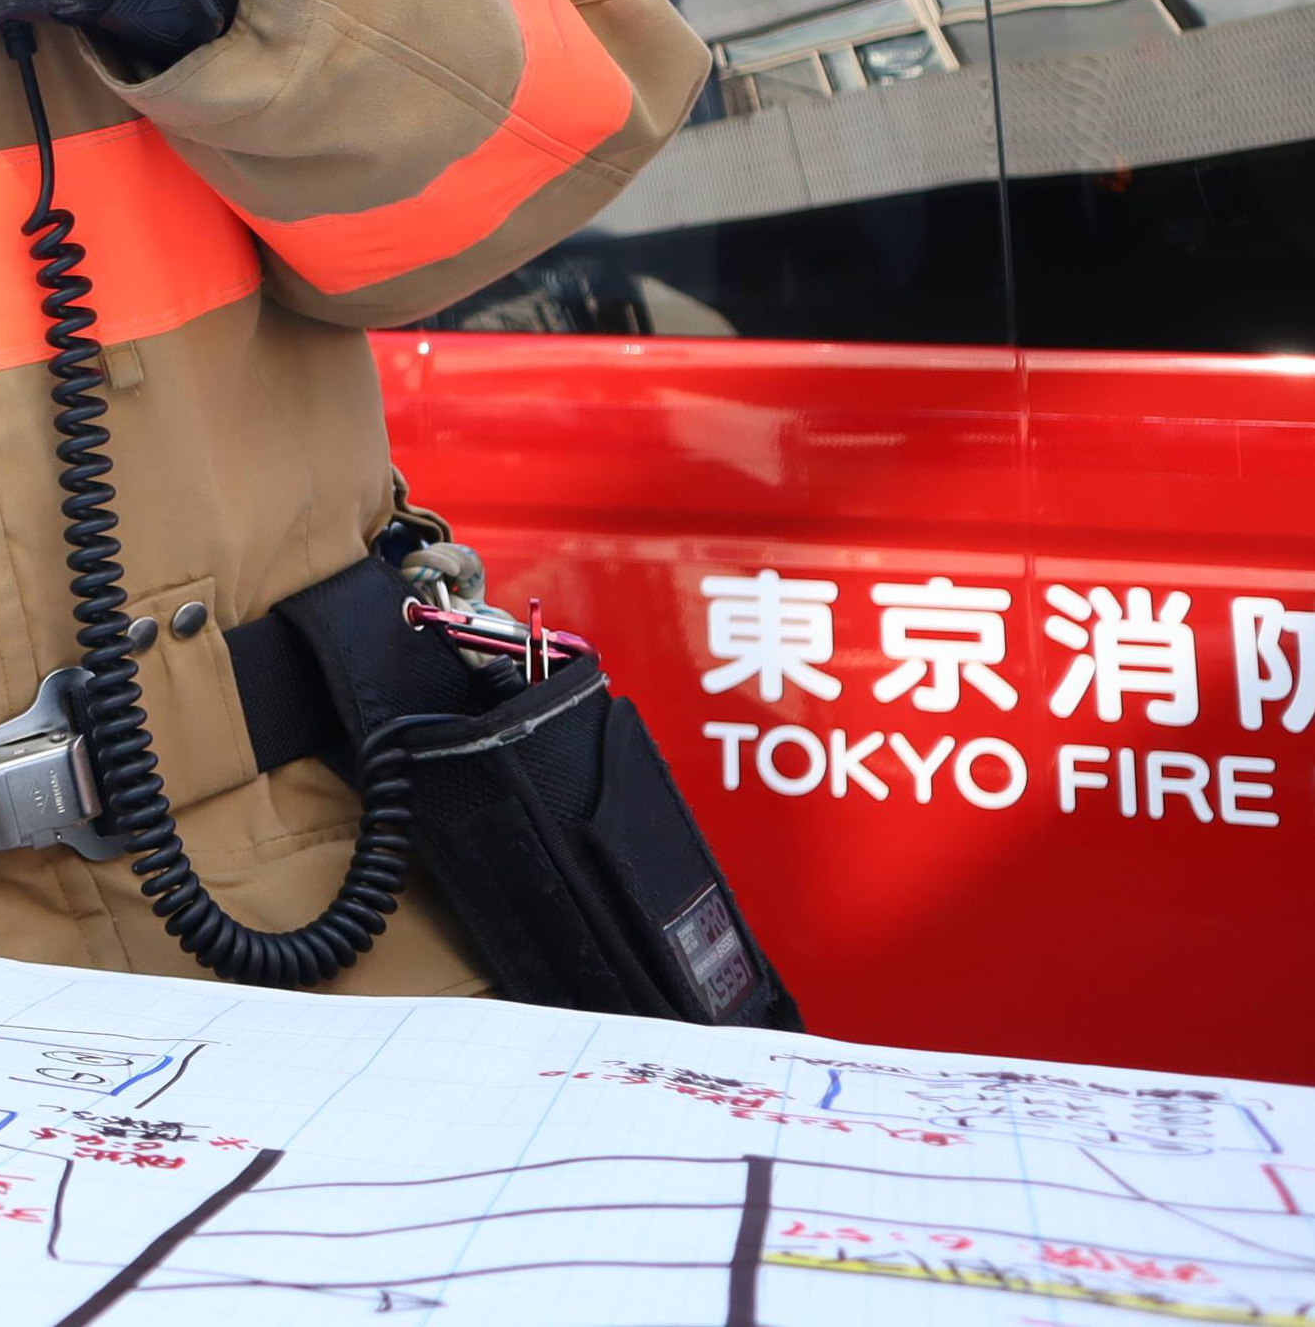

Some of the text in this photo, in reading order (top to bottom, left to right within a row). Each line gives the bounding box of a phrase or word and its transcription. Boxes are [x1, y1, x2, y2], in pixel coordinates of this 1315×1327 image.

[702, 720, 1281, 828] TOKYO FIRE
[697, 893, 731, 946] PRO
